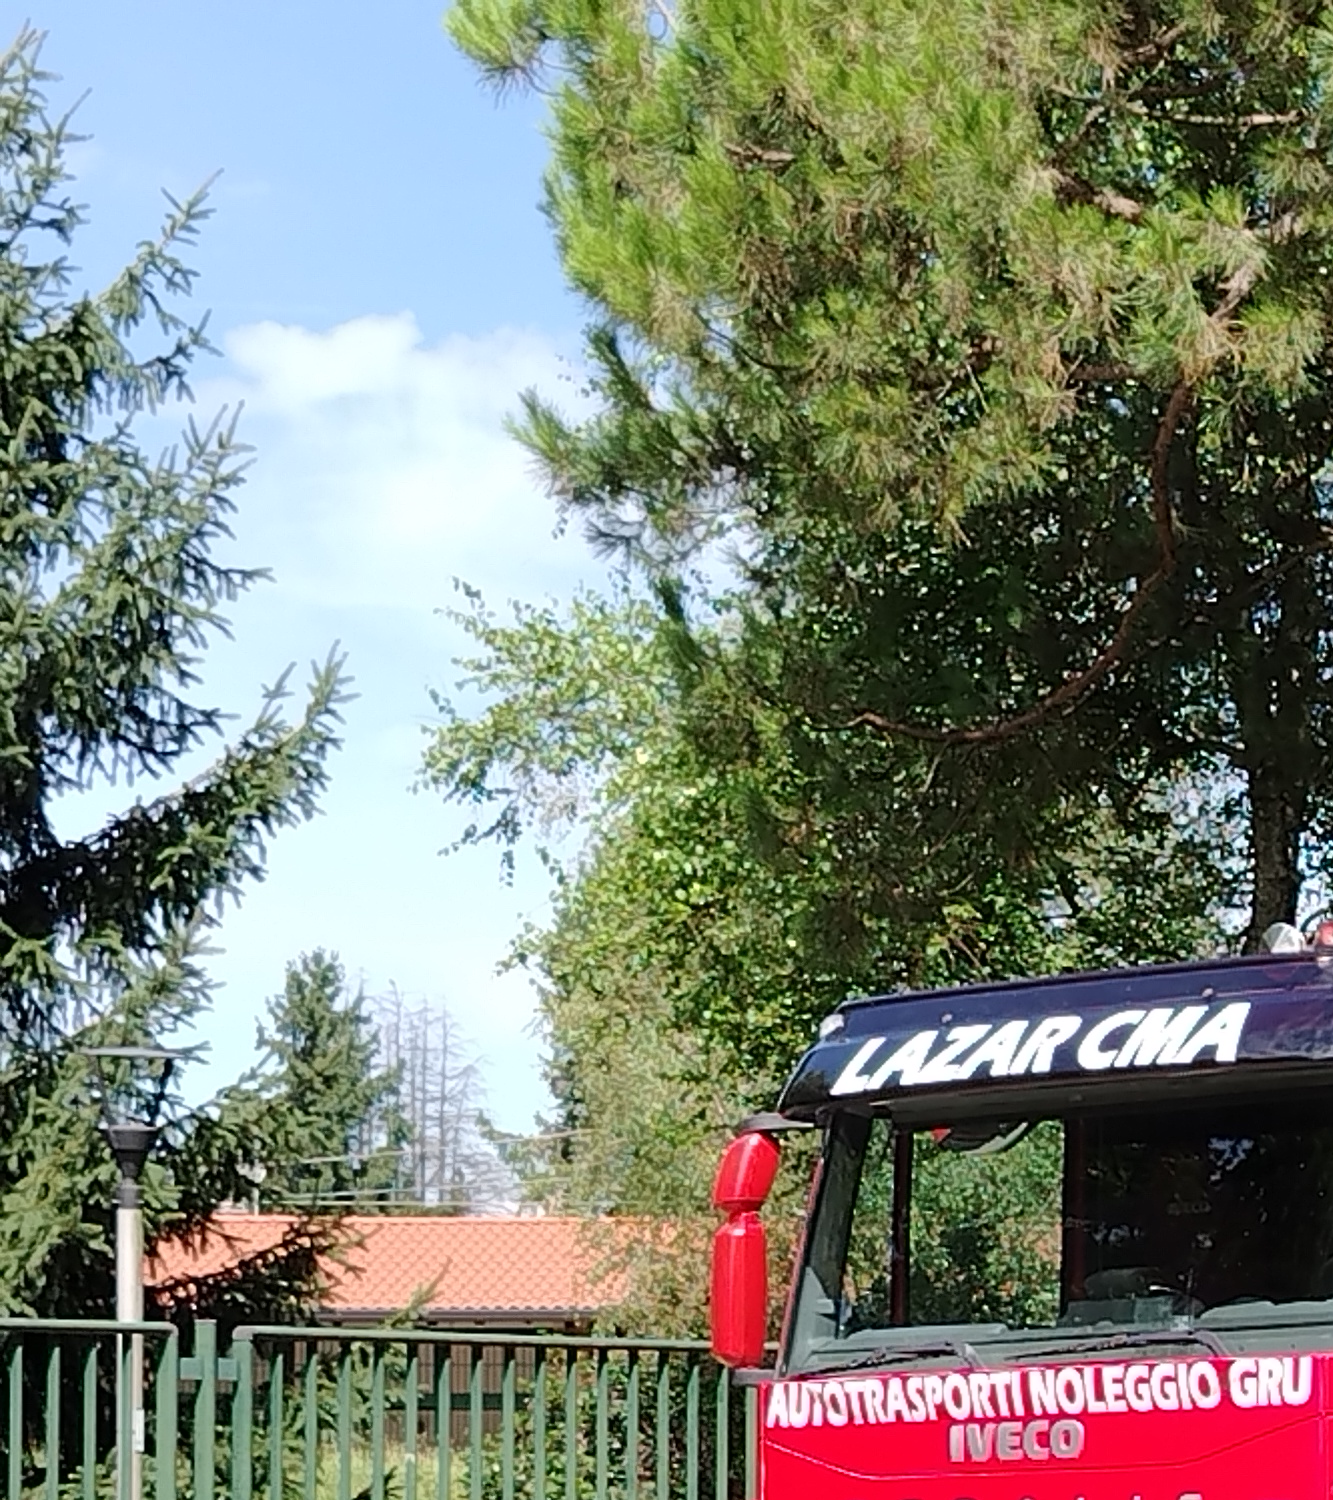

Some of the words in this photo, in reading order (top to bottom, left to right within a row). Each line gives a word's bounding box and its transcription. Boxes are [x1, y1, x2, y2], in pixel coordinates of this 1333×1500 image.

[830, 1013, 1082, 1097] LAZAR
[1077, 1002, 1251, 1071] CMA
[766, 1366, 1026, 1431] AUTOTRASPORTI
[1031, 1359, 1219, 1415] NOLEGGIO
[1228, 1355, 1313, 1408] GRU
[949, 1418, 1085, 1464] IVECO
